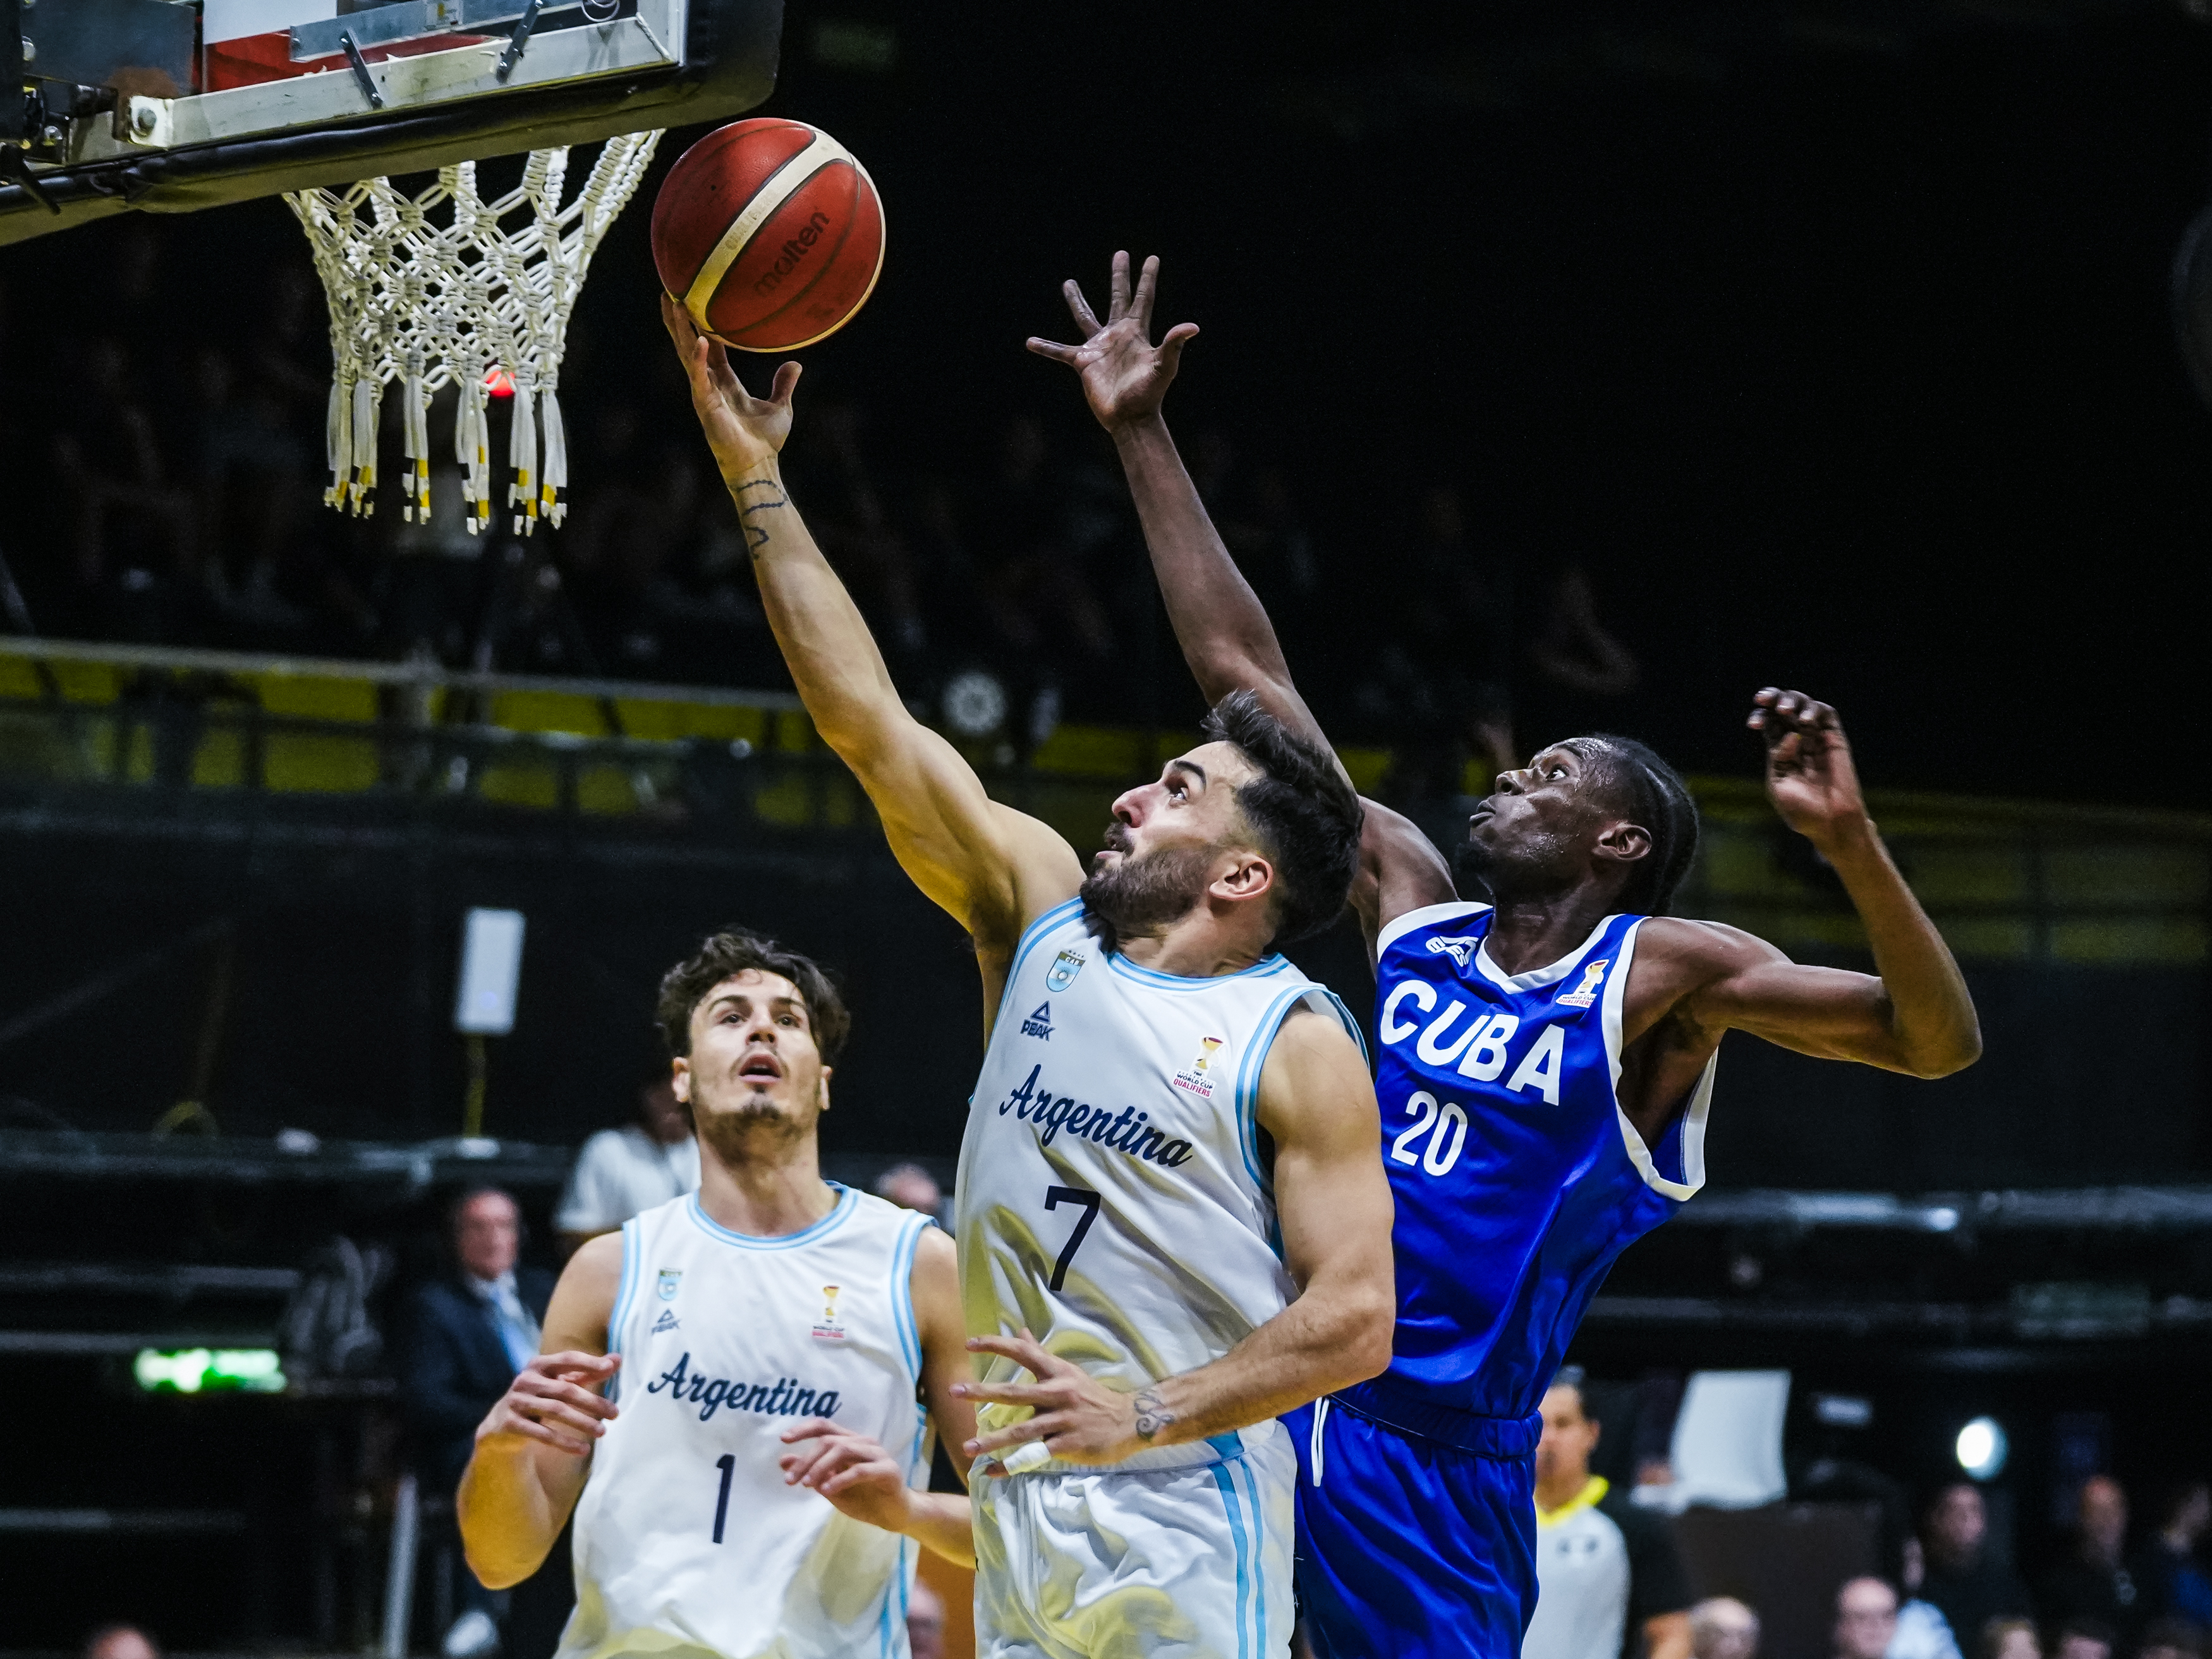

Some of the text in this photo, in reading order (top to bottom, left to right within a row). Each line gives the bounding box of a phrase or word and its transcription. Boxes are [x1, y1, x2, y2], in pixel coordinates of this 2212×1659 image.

[754, 212, 829, 296] molten
[1020, 1019, 1055, 1042] PEAK
[1381, 980, 1565, 1105] CUBA
[999, 1064, 1193, 1167] Argentina
[1174, 1078, 1211, 1097] QUALIFIERS
[1177, 1073, 1200, 1085] WORLD
[1391, 1091, 1468, 1176] 20
[1045, 1186, 1101, 1291] 7
[648, 1351, 842, 1421] Argentina
[712, 1454, 736, 1544] 1
